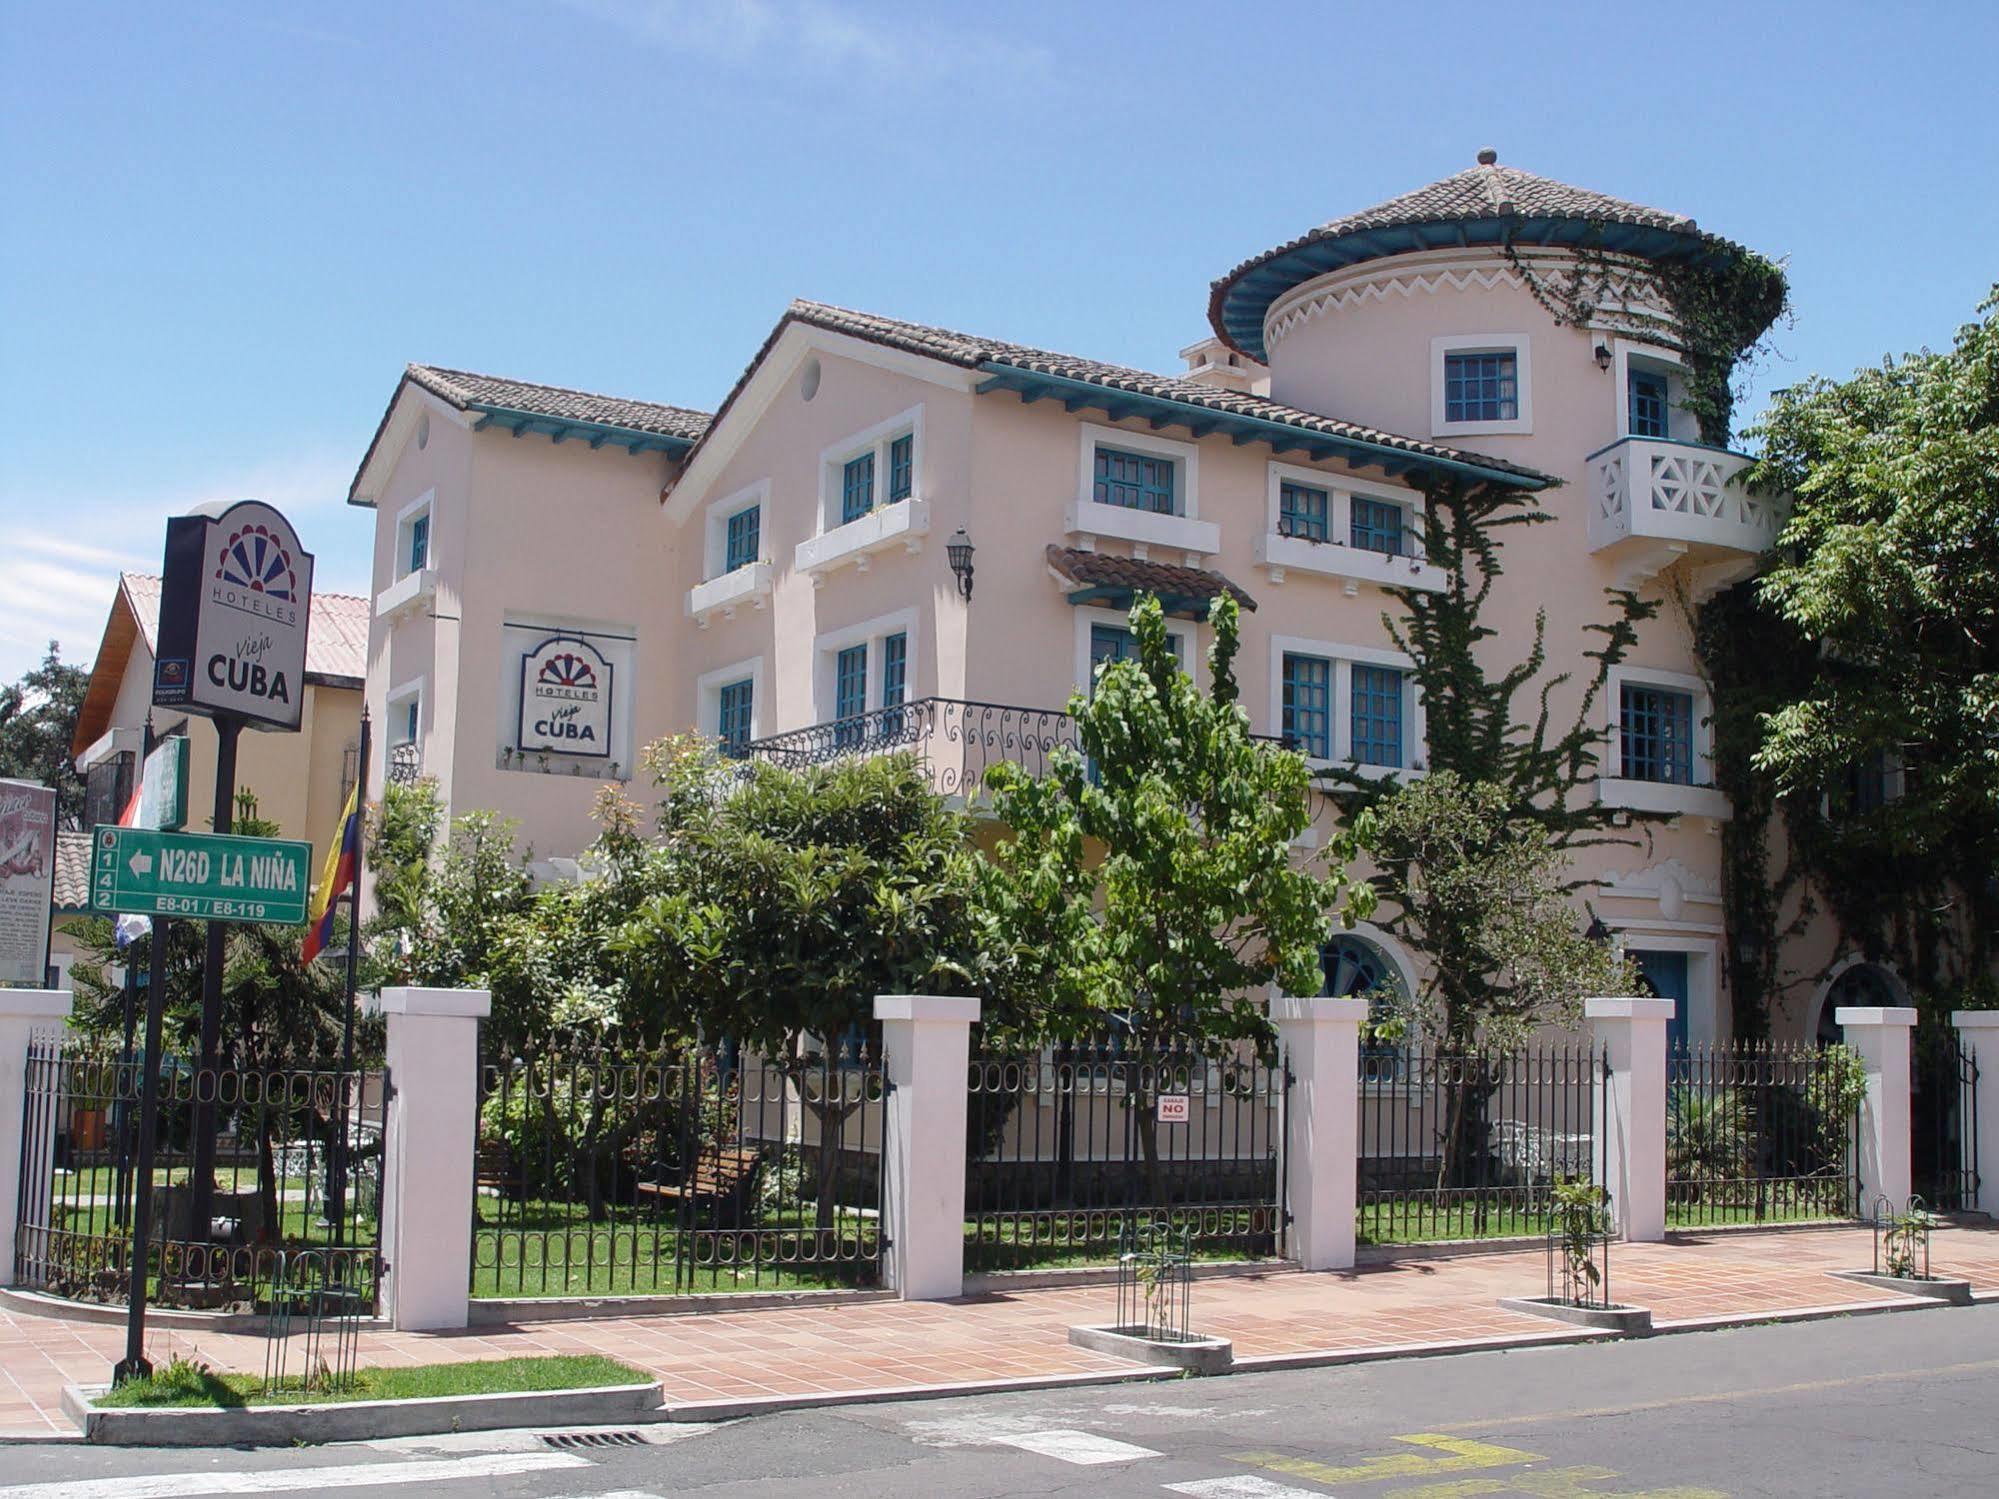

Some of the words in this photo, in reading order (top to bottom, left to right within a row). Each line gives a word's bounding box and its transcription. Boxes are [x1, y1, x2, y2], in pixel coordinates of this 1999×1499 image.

[213, 587, 296, 623] HOTELES
[236, 632, 272, 663] Vieja
[208, 654, 289, 704] CUBA
[536, 687, 598, 699] HOTELES
[552, 704, 582, 721] Vieja
[535, 720, 596, 741] CUBA
[102, 852, 113, 867] 1
[160, 849, 210, 884] N26D
[220, 854, 244, 887] LA
[250, 851, 296, 891] NIÑA
[100, 873, 113, 888] 4
[99, 892, 110, 906] 2
[156, 897, 198, 913] E8-01
[213, 901, 265, 917] E8-119
[1163, 1105, 1184, 1113] NO
